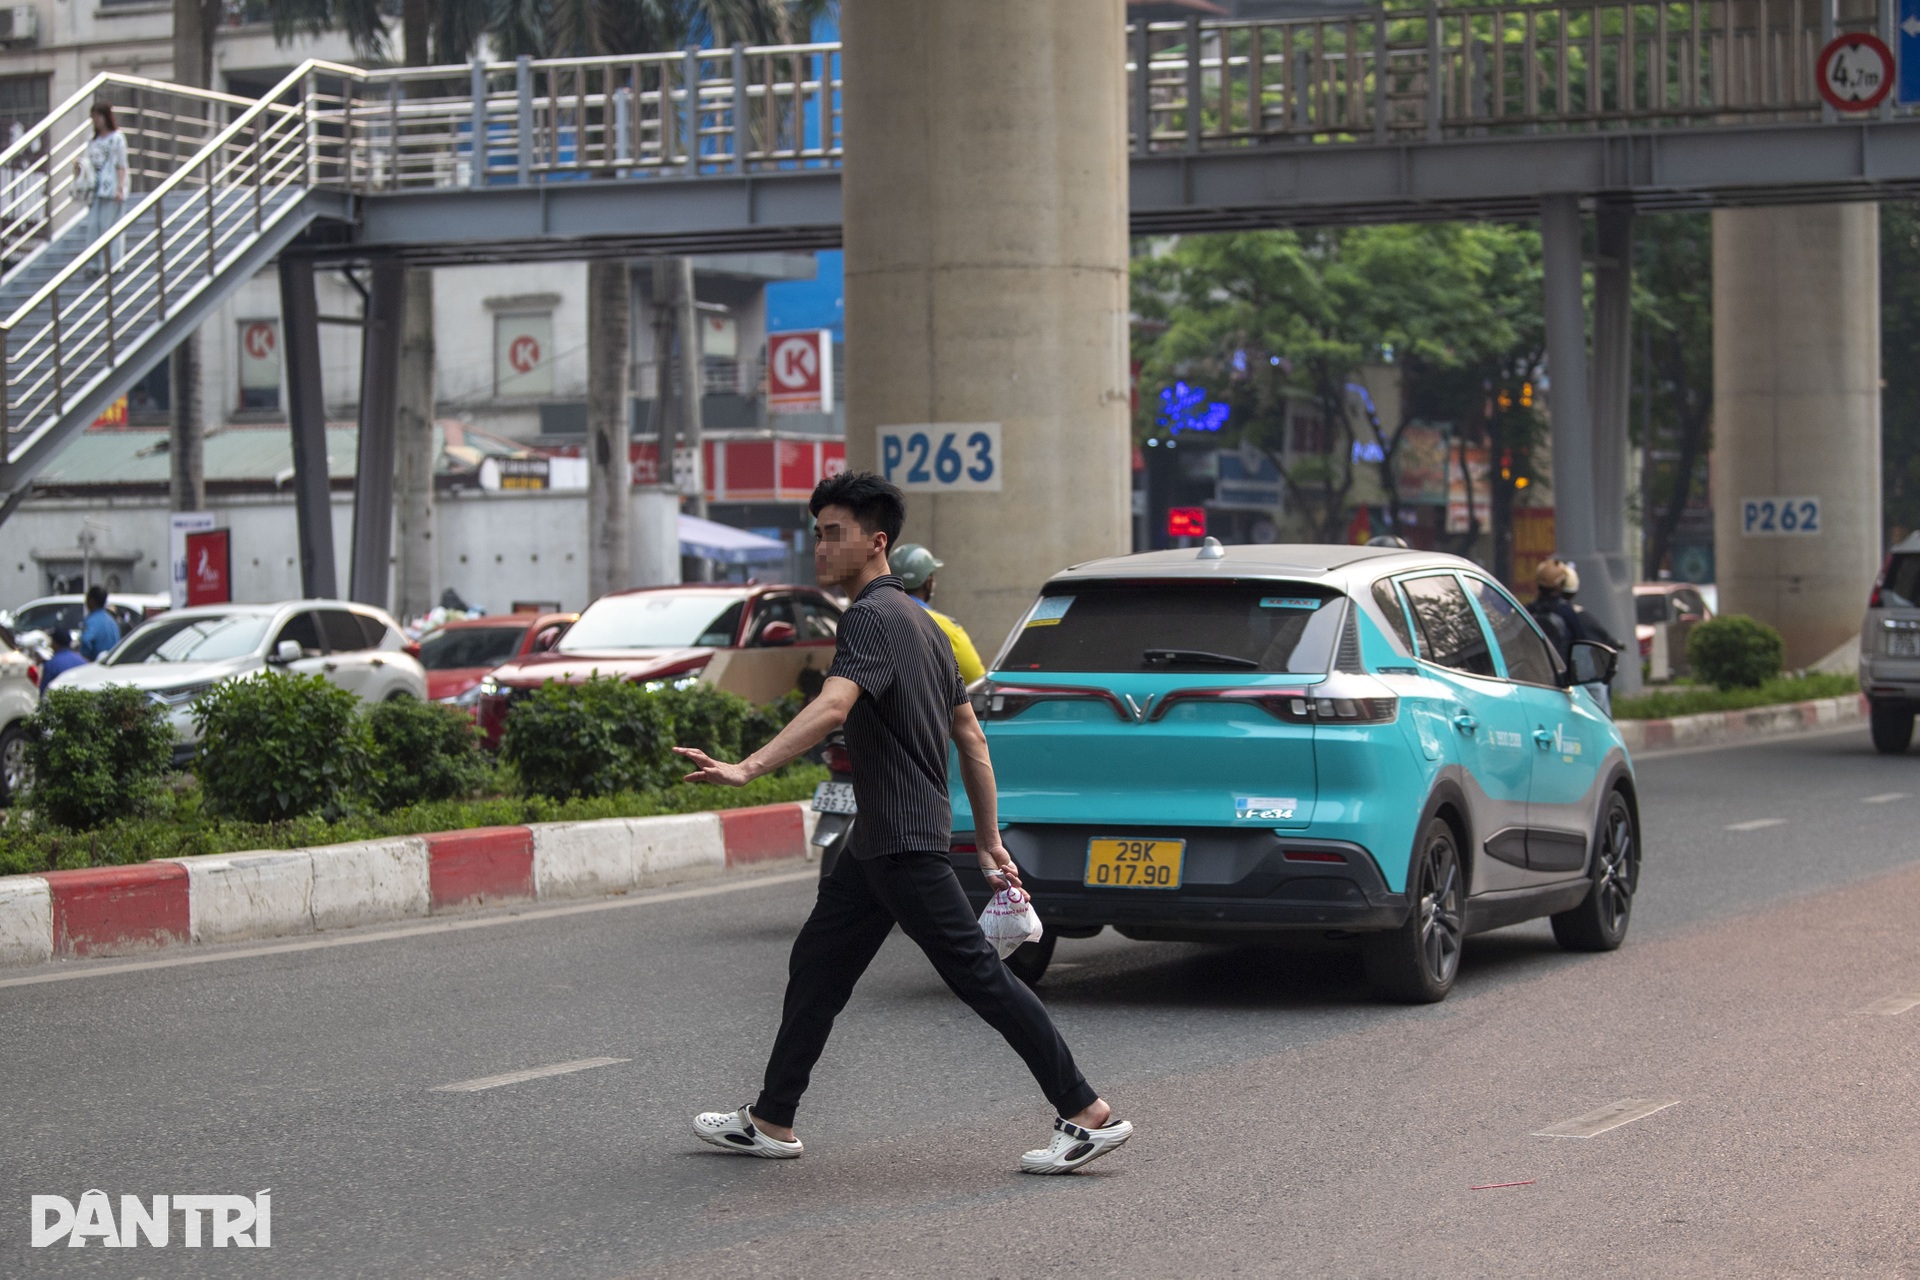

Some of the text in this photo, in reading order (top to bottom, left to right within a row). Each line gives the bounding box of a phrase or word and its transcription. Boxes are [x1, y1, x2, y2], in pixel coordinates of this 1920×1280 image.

[782, 346, 813, 382] K
[882, 431, 995, 484] P263
[1744, 501, 1819, 532] P262
[1115, 841, 1157, 862] 29K
[1097, 863, 1171, 886] 017.90
